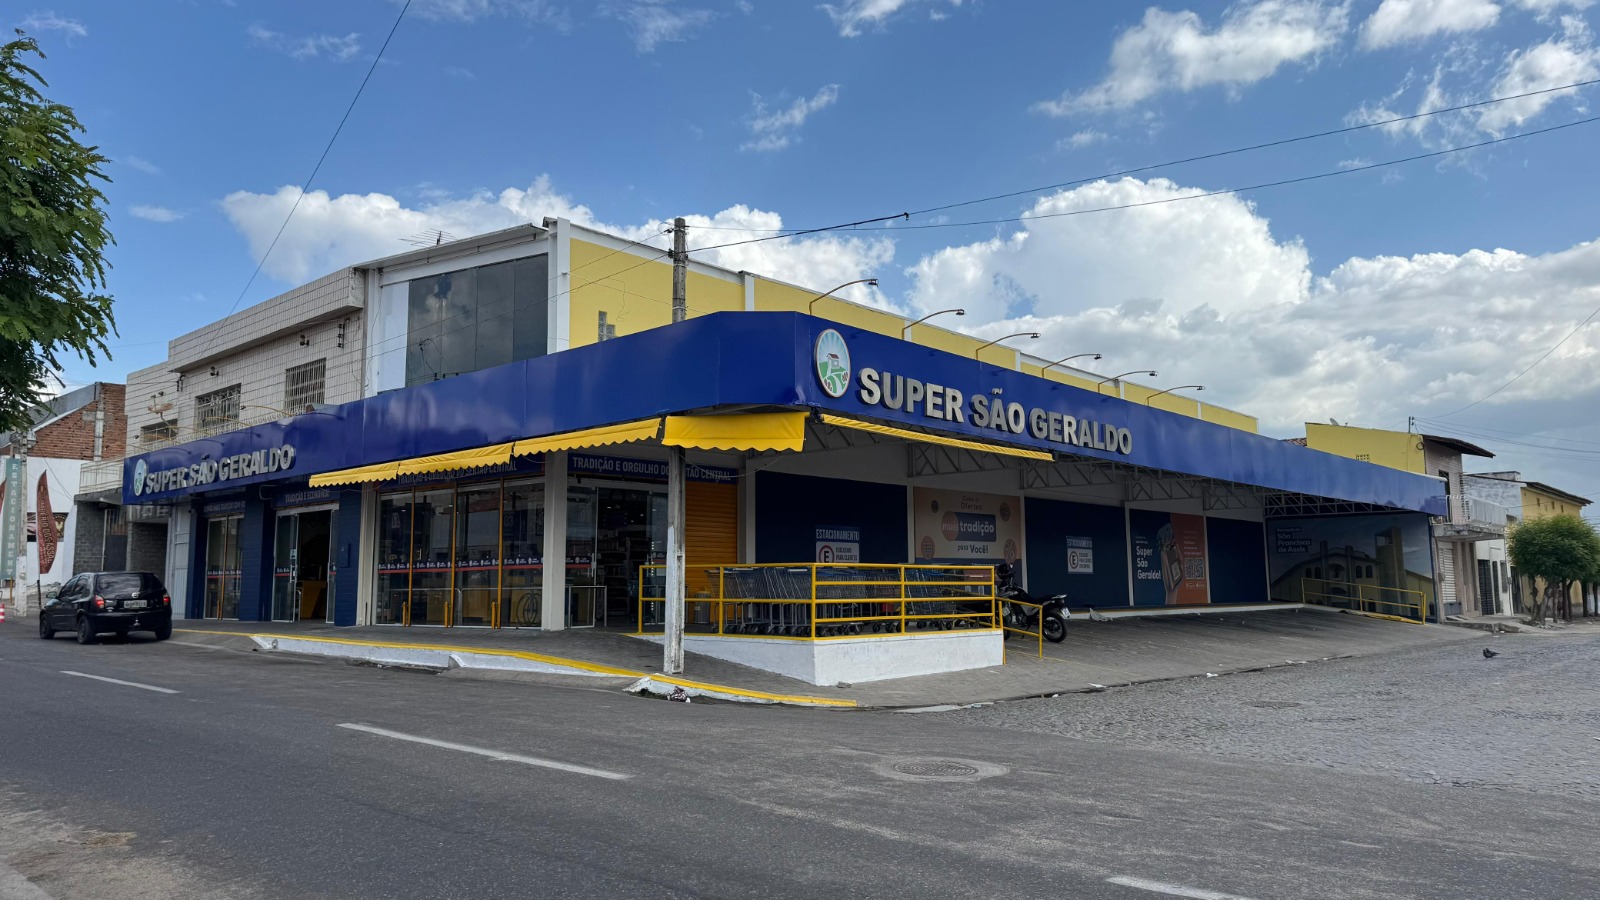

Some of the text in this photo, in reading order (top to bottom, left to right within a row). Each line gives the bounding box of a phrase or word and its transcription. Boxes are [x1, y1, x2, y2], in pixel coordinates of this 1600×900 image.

[858, 367, 1133, 456] SUPER SÃO GERALDO
[145, 443, 296, 495] SUPER SÃO GERALDO
[572, 456, 614, 473] TRADIÇÃO
[615, 460, 621, 472] E
[622, 461, 659, 475] ORGULHO
[700, 469, 732, 482] CENTRAL
[960, 502, 983, 511] Ofertas
[815, 528, 860, 541] ESTACIONAMENTO
[942, 520, 995, 537] mais tradição
[1277, 532, 1291, 540] São
[957, 544, 989, 554] para Você!
[1277, 539, 1311, 547] Francisco
[1135, 545, 1153, 558] Super
[1136, 557, 1149, 568] São
[1137, 569, 1162, 580] Geraldo!
